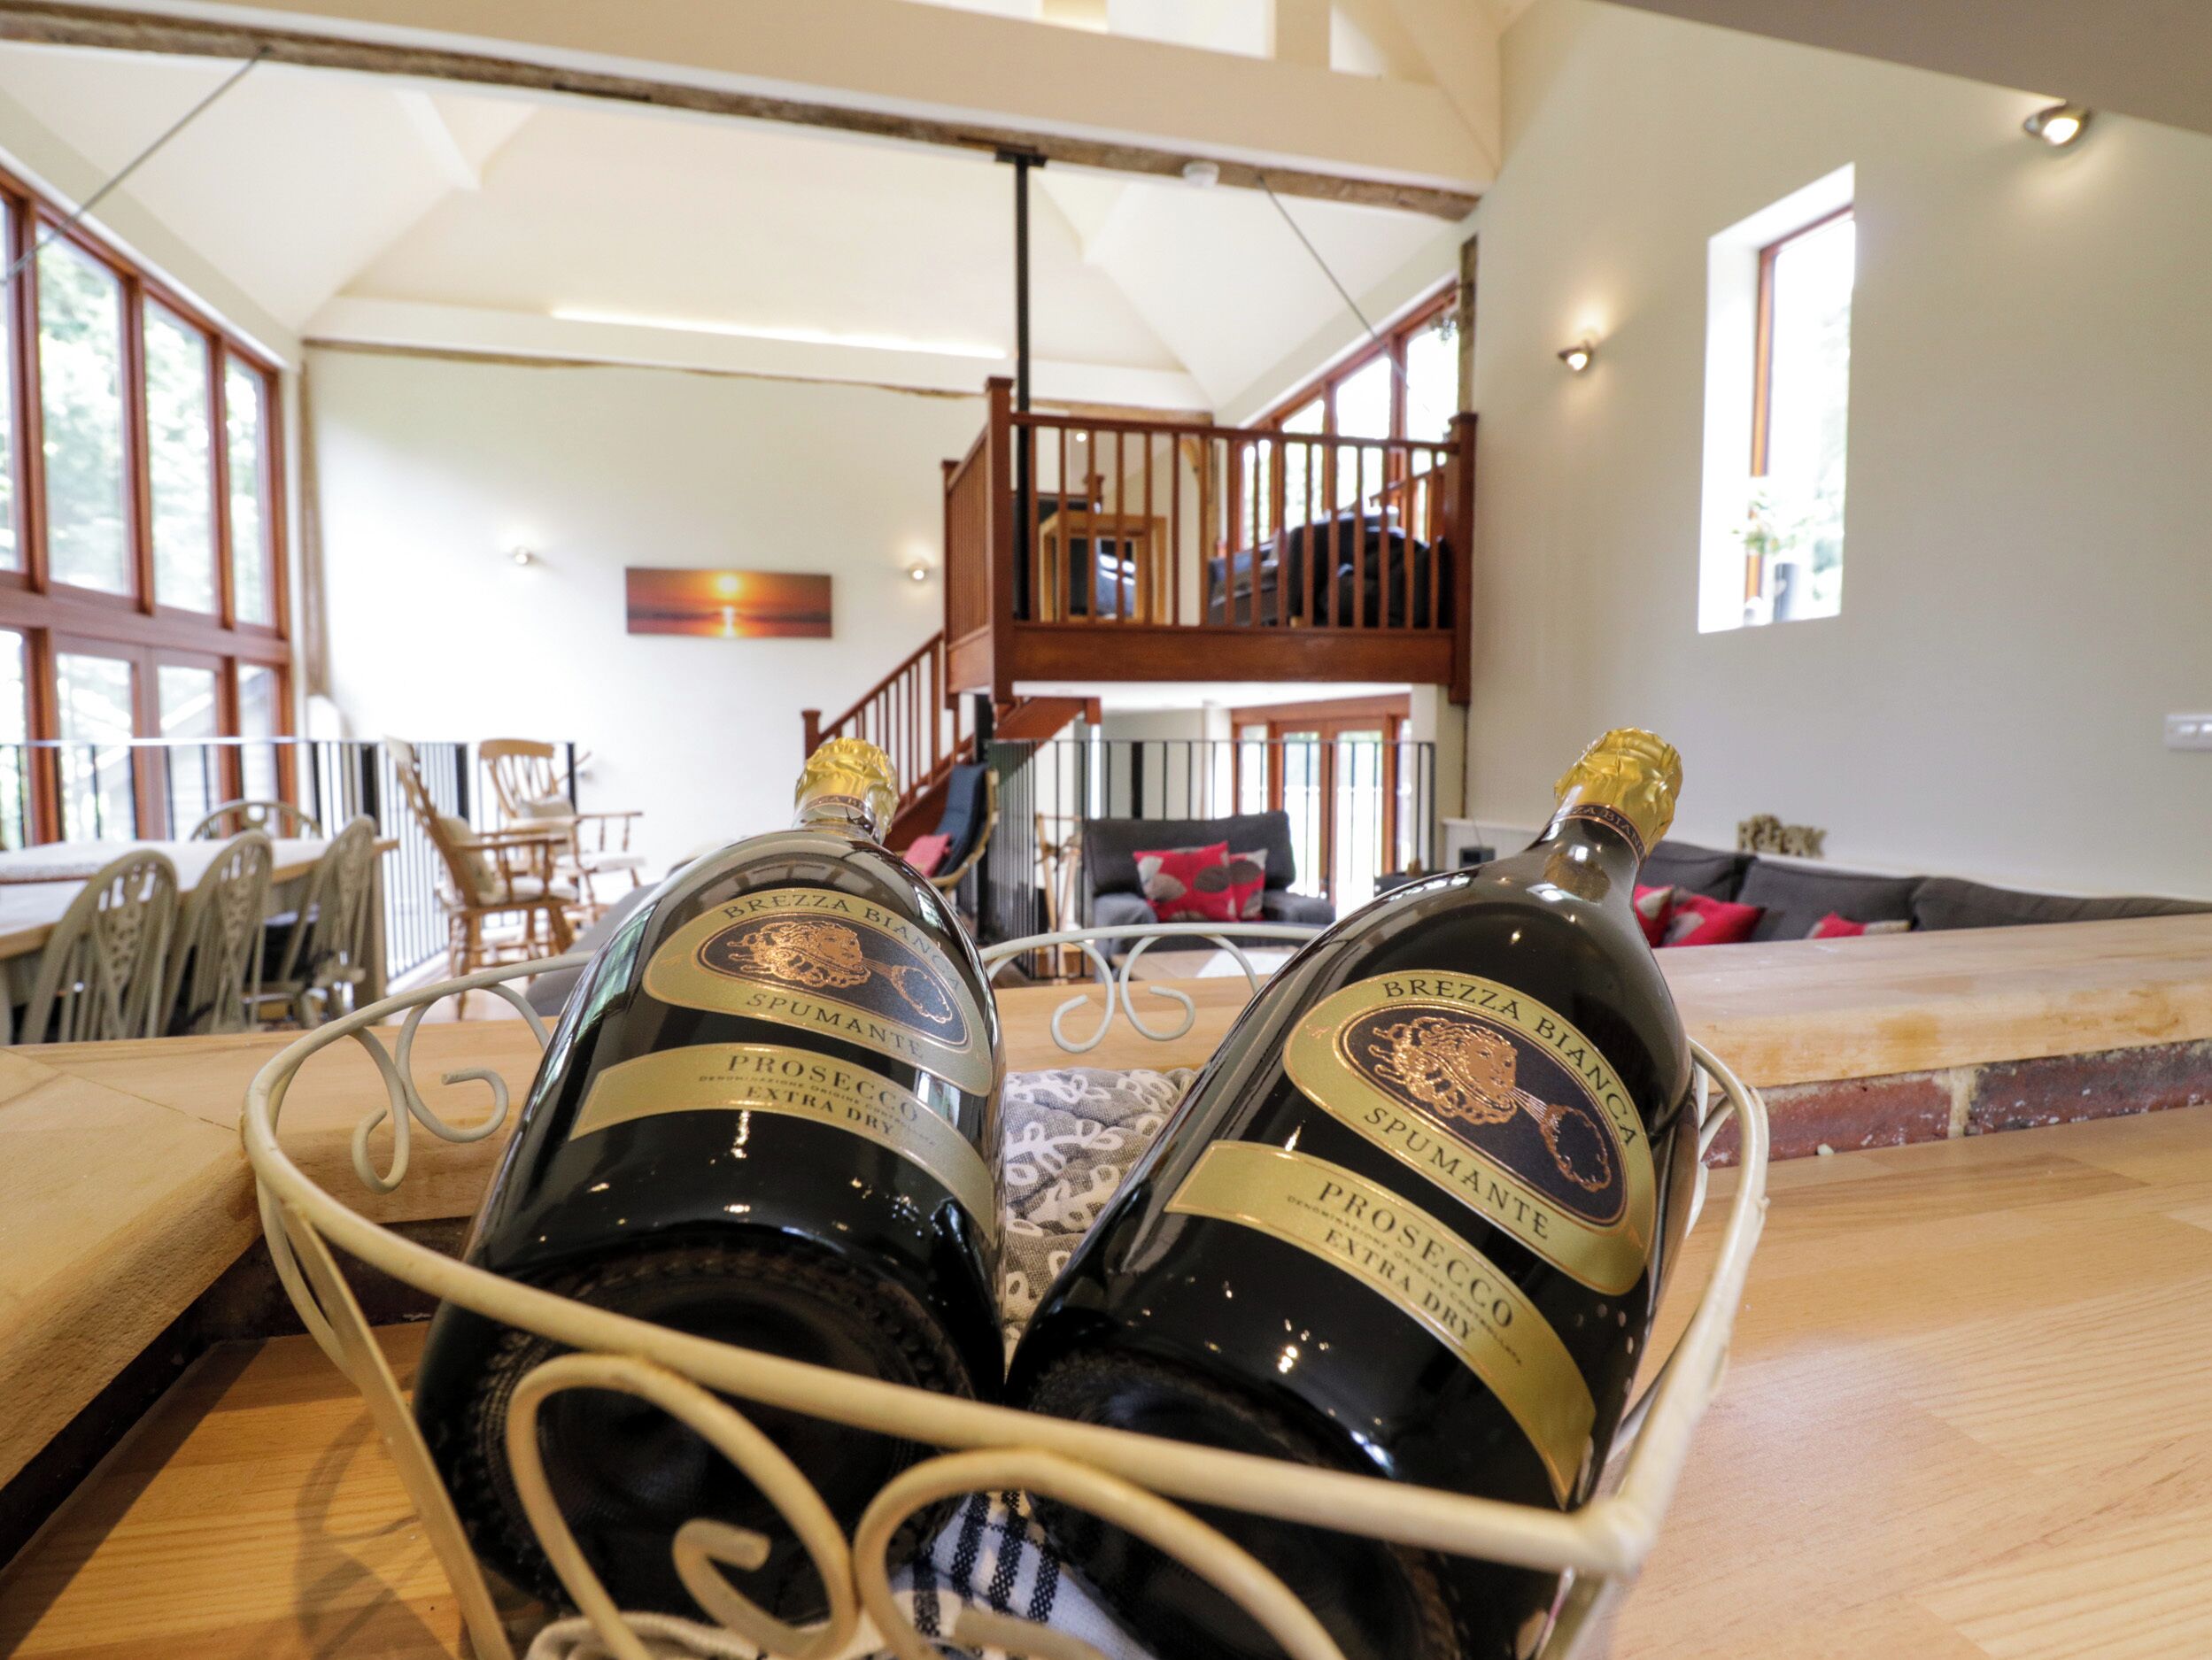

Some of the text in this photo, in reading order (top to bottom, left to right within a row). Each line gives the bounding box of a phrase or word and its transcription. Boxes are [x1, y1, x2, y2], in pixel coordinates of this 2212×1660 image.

[723, 894, 960, 990] BREZZA BIANCA
[746, 992, 924, 1060] SPUMANTE
[1382, 978, 1637, 1147] BREZZA BIANCA
[727, 1054, 919, 1123] PROSECCO
[746, 1085, 897, 1135] EXTRA DRY
[1364, 1107, 1550, 1240] SPUMANTE
[1318, 1181, 1513, 1328] PROSECCO
[1325, 1228, 1477, 1340] EXTRA DRY
